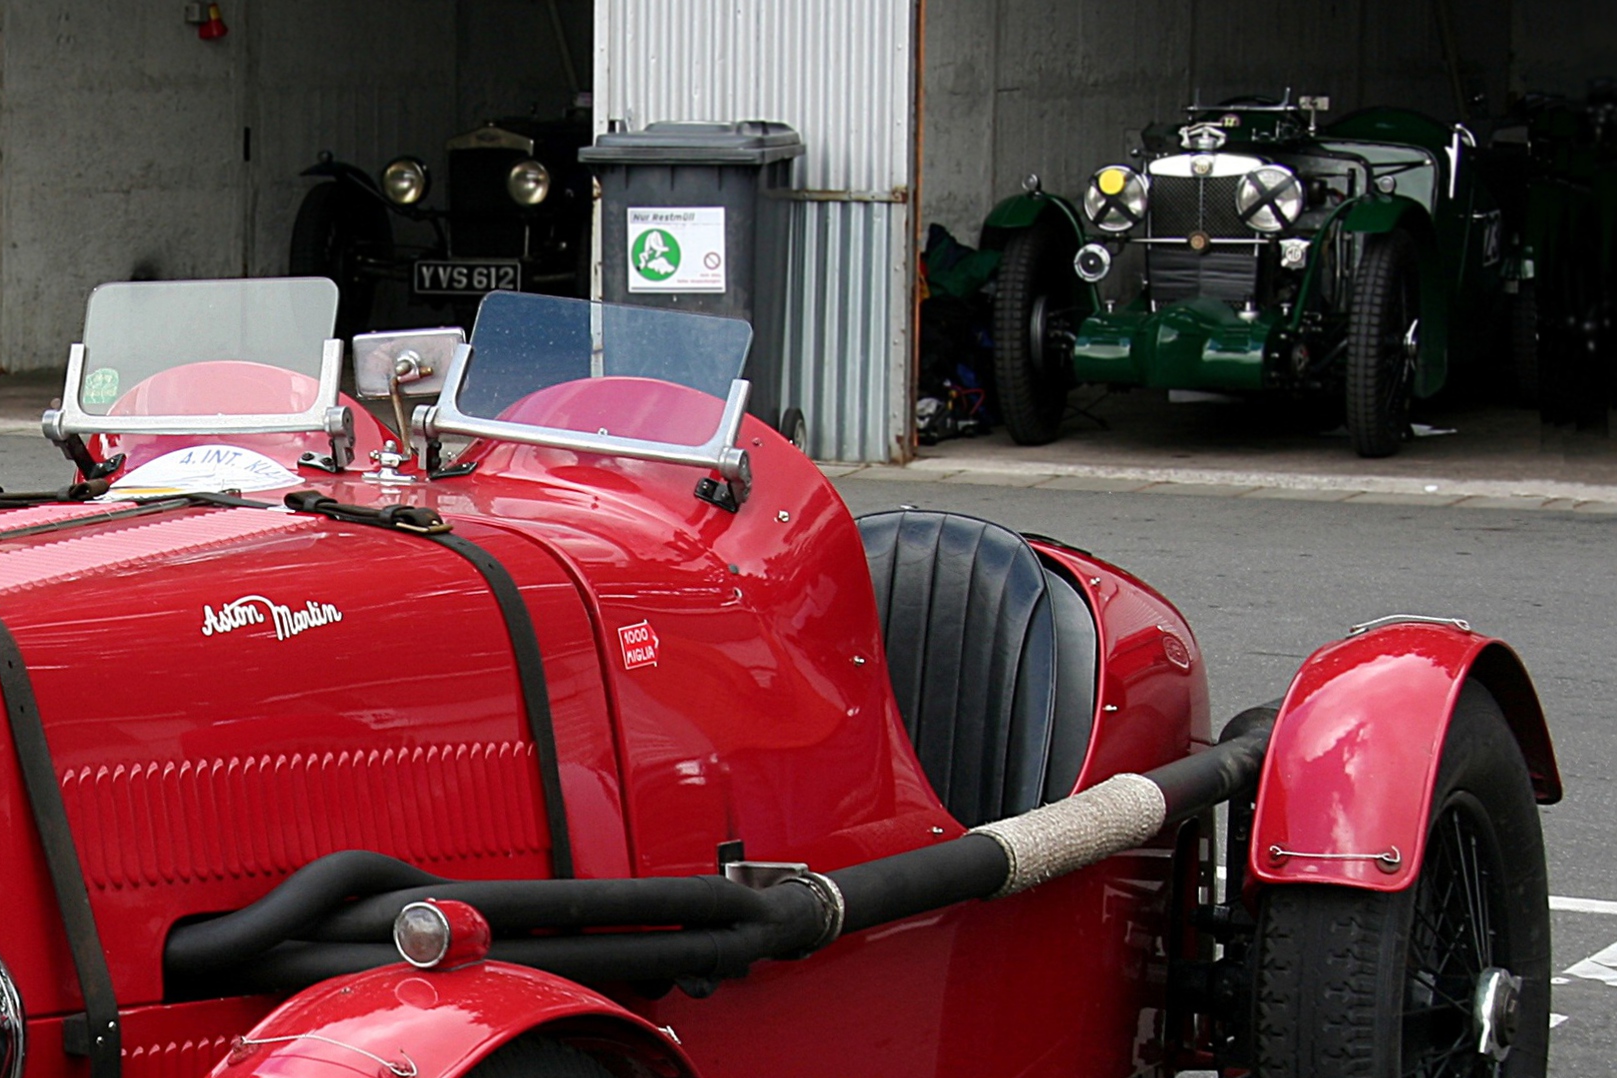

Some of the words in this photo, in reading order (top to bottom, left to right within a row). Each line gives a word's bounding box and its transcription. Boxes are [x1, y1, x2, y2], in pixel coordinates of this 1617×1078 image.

[633, 213, 649, 221] Nur
[421, 266, 468, 289] YVS
[472, 266, 515, 289] 612
[202, 595, 266, 636] Aston
[272, 600, 342, 641] Martin
[624, 627, 649, 645] 1000
[626, 645, 656, 664] MIGLIA
